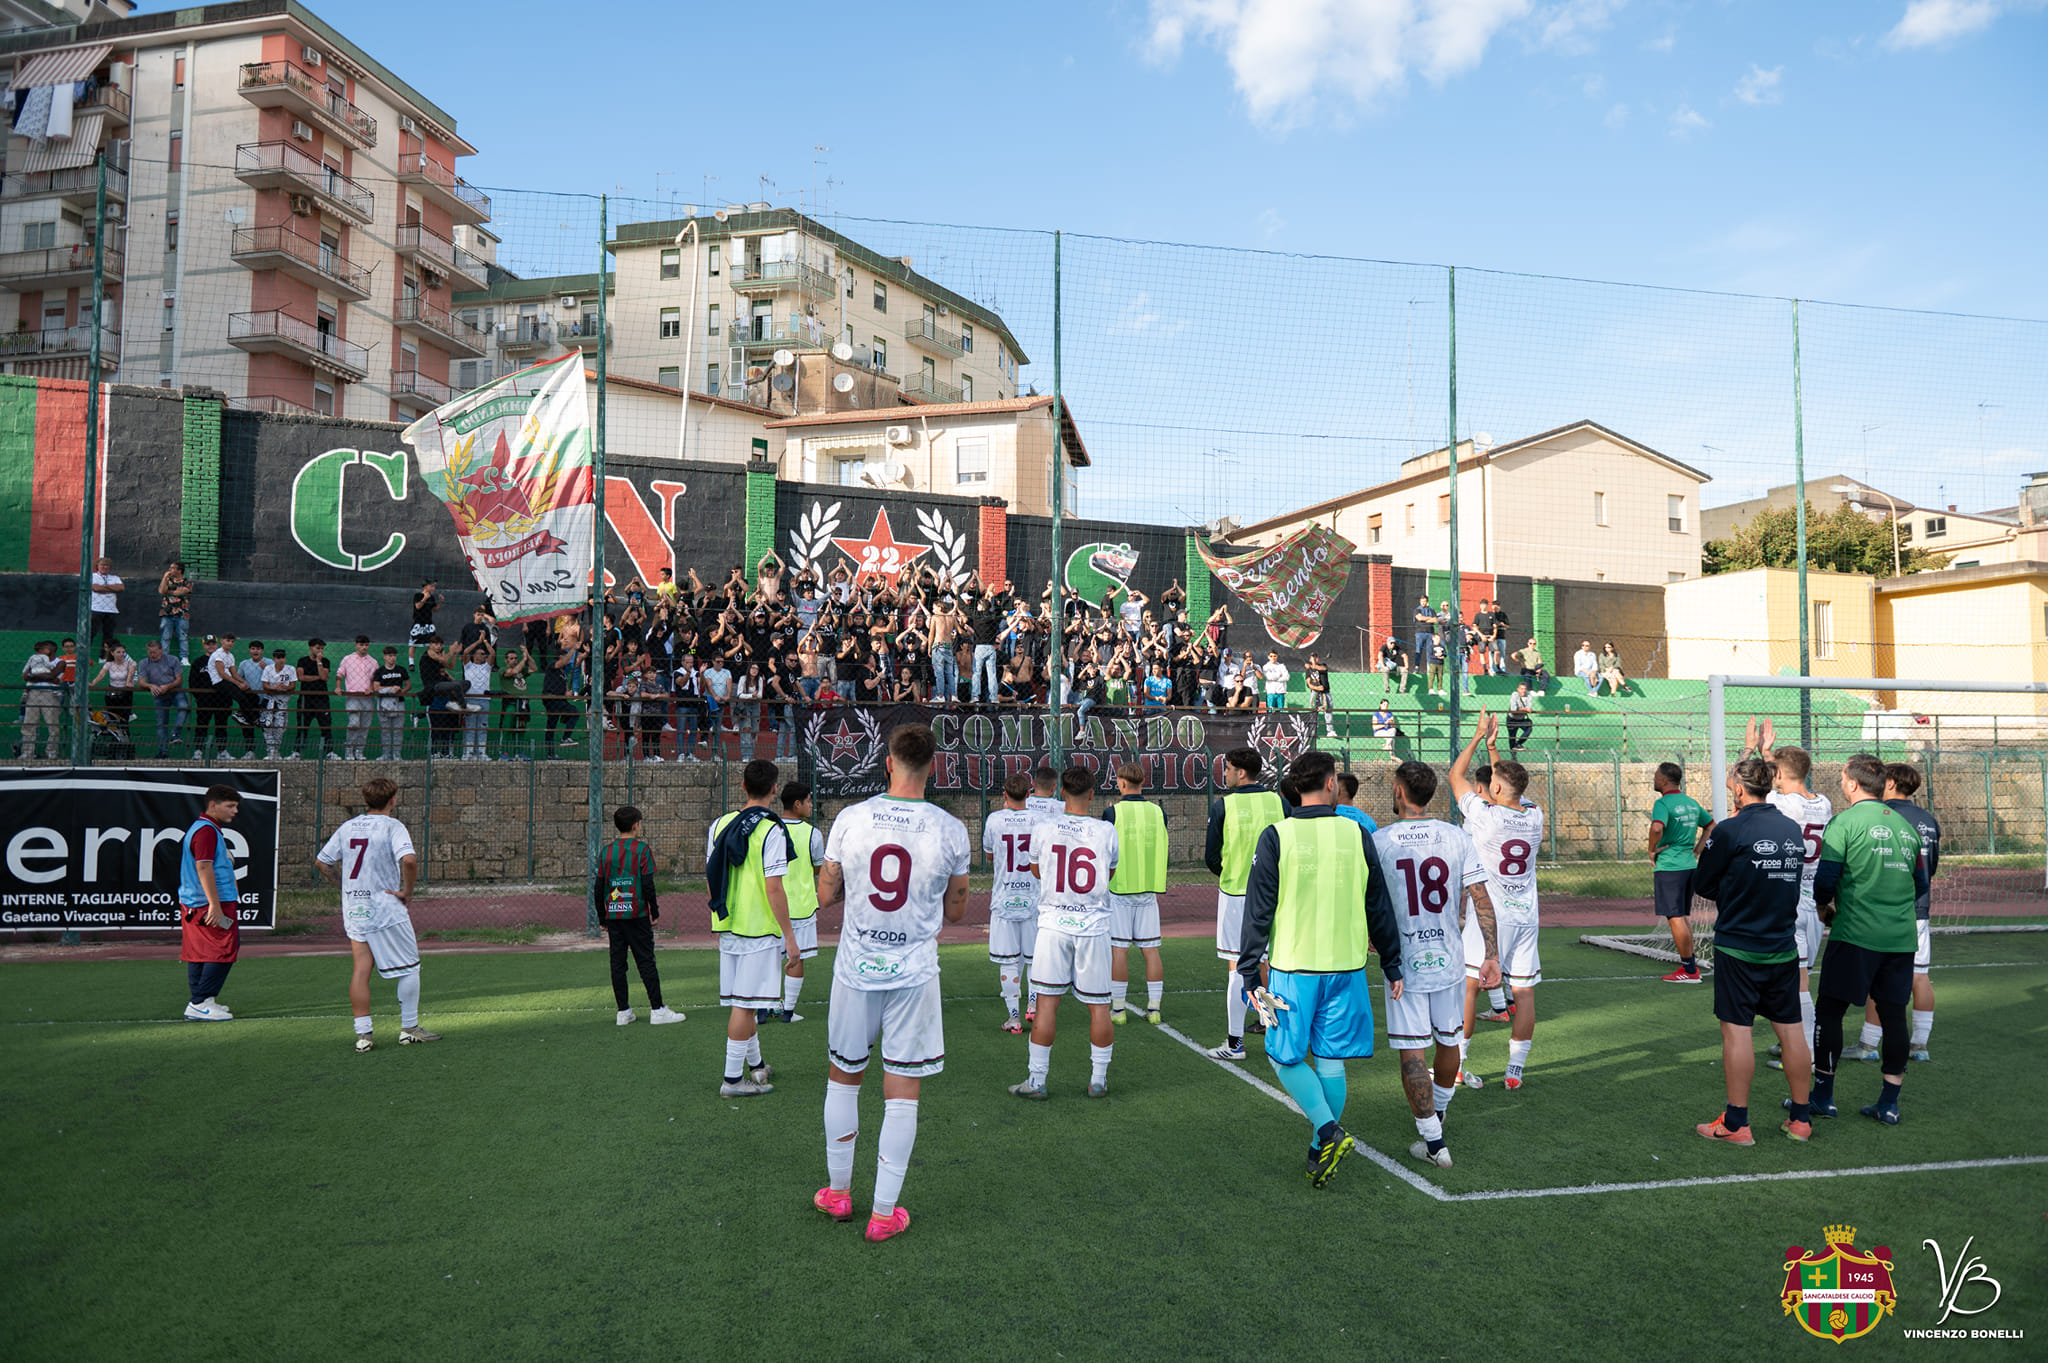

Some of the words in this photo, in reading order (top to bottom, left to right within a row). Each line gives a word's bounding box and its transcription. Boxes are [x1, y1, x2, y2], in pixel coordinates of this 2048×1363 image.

[291, 448, 408, 572] C
[587, 474, 687, 589] N
[862, 545, 900, 574] 22
[834, 735, 856, 749] 22
[930, 714, 1205, 752] COMMANDO
[840, 782, 886, 796] Cataldo
[932, 752, 1228, 791] EURPATIC
[873, 812, 910, 825] PICODA
[1397, 832, 1430, 841] PICODA
[349, 838, 369, 880] 7
[1001, 833, 1032, 873] 13
[1498, 838, 1532, 876] 8
[1803, 822, 1824, 864] 5
[868, 843, 913, 912] 9
[1051, 844, 1097, 894] 16
[1395, 856, 1450, 917] 18
[2, 893, 68, 907] INTERNE,
[71, 893, 175, 906] TAGLIAFUOCO,
[2, 911, 61, 923] Gaetano
[63, 910, 126, 925] Vivacqua
[139, 910, 171, 921] info:
[870, 929, 907, 942] ZODA
[1416, 928, 1445, 940] ZODA
